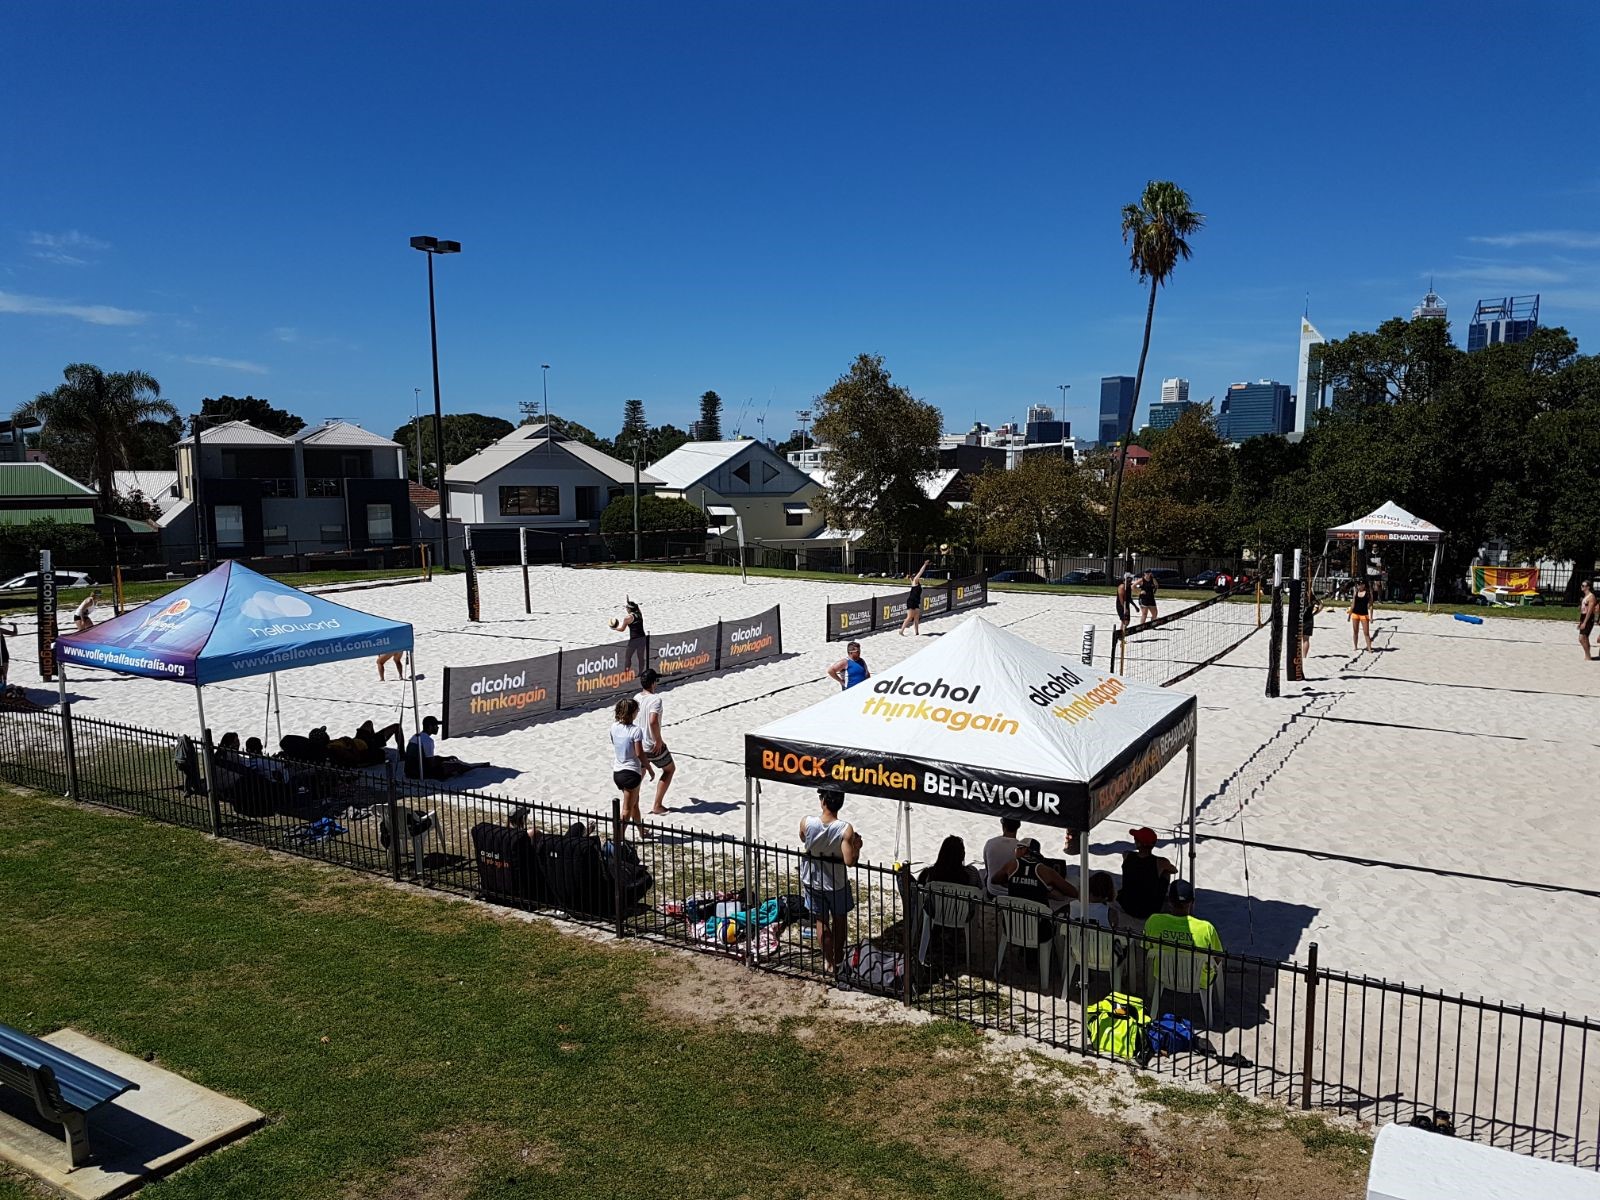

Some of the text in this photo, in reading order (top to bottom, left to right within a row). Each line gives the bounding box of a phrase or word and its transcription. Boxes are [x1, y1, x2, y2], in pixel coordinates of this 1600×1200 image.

[1388, 533, 1430, 542] BEHAVIOUR
[247, 618, 341, 638] helloworld
[731, 621, 762, 643] alcohol
[232, 635, 391, 671] www.helloworld.com.au
[658, 638, 698, 658] alcohol
[730, 634, 772, 657] thinkagain
[63, 646, 185, 677] www.volleyballaustralia.org
[576, 652, 618, 676] alcohol
[658, 650, 711, 674] thinkagain
[470, 670, 526, 695] alcohol
[576, 667, 636, 694] thinkagain
[873, 676, 981, 704] alcohol
[1029, 666, 1084, 707] alcohol
[470, 686, 546, 716] thinkagain
[1051, 676, 1127, 725] thinkagain
[861, 696, 1020, 736] thinkagain
[1159, 712, 1195, 757] BEHAVIOUR
[762, 749, 1061, 816] BLOCK drunken BEHAVIOUR
[1162, 929, 1194, 943] SVEN
